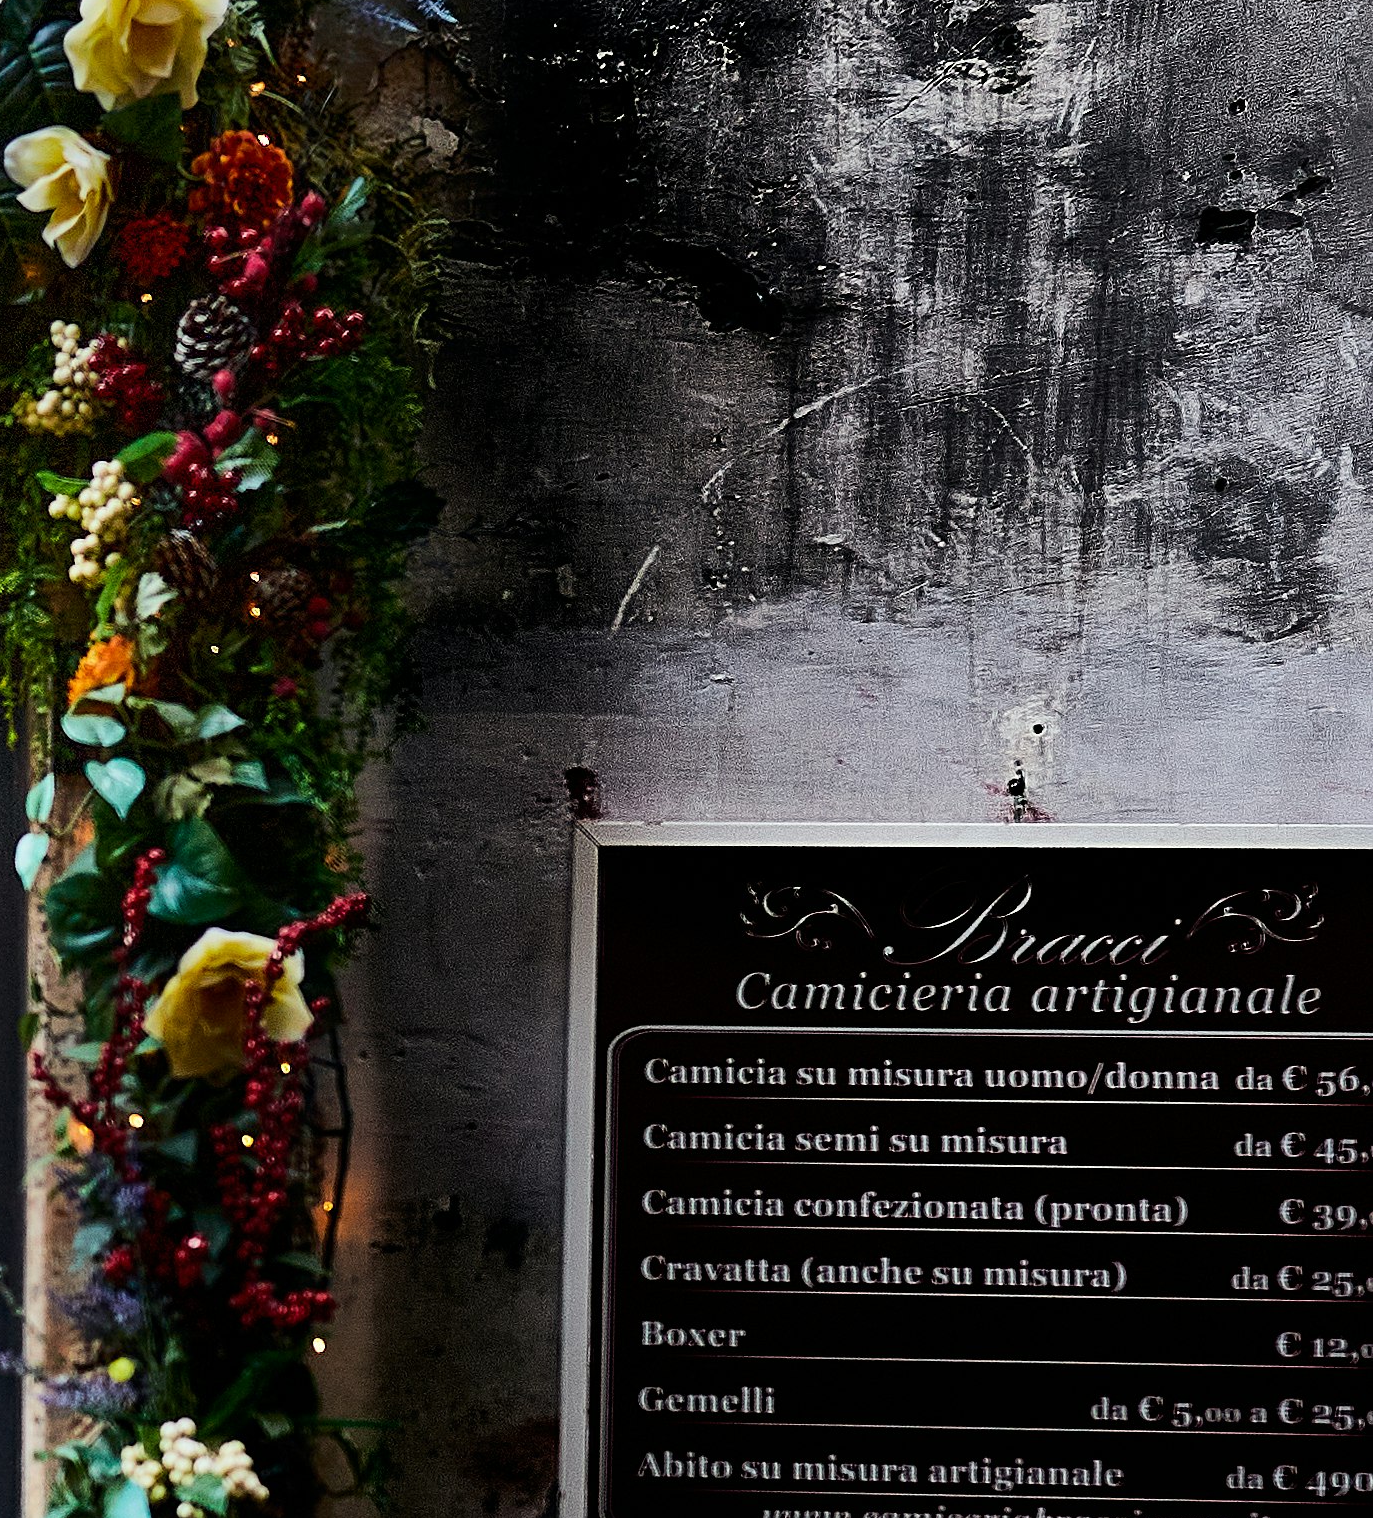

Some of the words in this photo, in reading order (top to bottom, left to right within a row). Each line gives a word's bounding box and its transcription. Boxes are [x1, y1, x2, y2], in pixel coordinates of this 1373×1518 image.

[883, 873, 1181, 965] Bracci
[736, 972, 1011, 1011] Camicieria
[1032, 974, 1321, 1023] artigianale
[645, 1058, 786, 1085] Camicia
[796, 1068, 836, 1085] su
[849, 1060, 973, 1087] misura
[985, 1062, 1219, 1094] uomo/donna
[1235, 1067, 1273, 1090] da
[1282, 1066, 1307, 1090] €
[1315, 1065, 1373, 1096] 56,
[644, 1124, 785, 1150] Camicia
[795, 1125, 879, 1151] semi
[889, 1135, 929, 1152] su
[941, 1127, 1067, 1154] misura
[1234, 1133, 1272, 1157] da
[1281, 1132, 1305, 1157] €
[642, 1189, 784, 1216] Camicia
[794, 1191, 1023, 1220] confezionata
[1035, 1195, 1188, 1228] (pronta)
[1279, 1199, 1304, 1224] €
[641, 1255, 790, 1282] Cravatta
[801, 1257, 923, 1287] (anche
[931, 1267, 972, 1285] su
[984, 1260, 1127, 1291] misura)
[1232, 1266, 1268, 1290] da
[1278, 1266, 1302, 1290] €
[642, 1321, 746, 1347] Boxer
[1277, 1332, 1301, 1357] €
[639, 1387, 774, 1413] Gemelli
[1091, 1397, 1127, 1420] da
[1139, 1396, 1163, 1421] €
[1172, 1403, 1241, 1427] 5,00
[1250, 1408, 1267, 1423] a
[1278, 1399, 1303, 1424] €
[638, 1451, 732, 1478] Abito
[741, 1462, 781, 1479] su
[793, 1455, 917, 1482] misura
[928, 1458, 1124, 1491] artigianale
[1227, 1466, 1263, 1489] da
[1273, 1465, 1297, 1490] €
